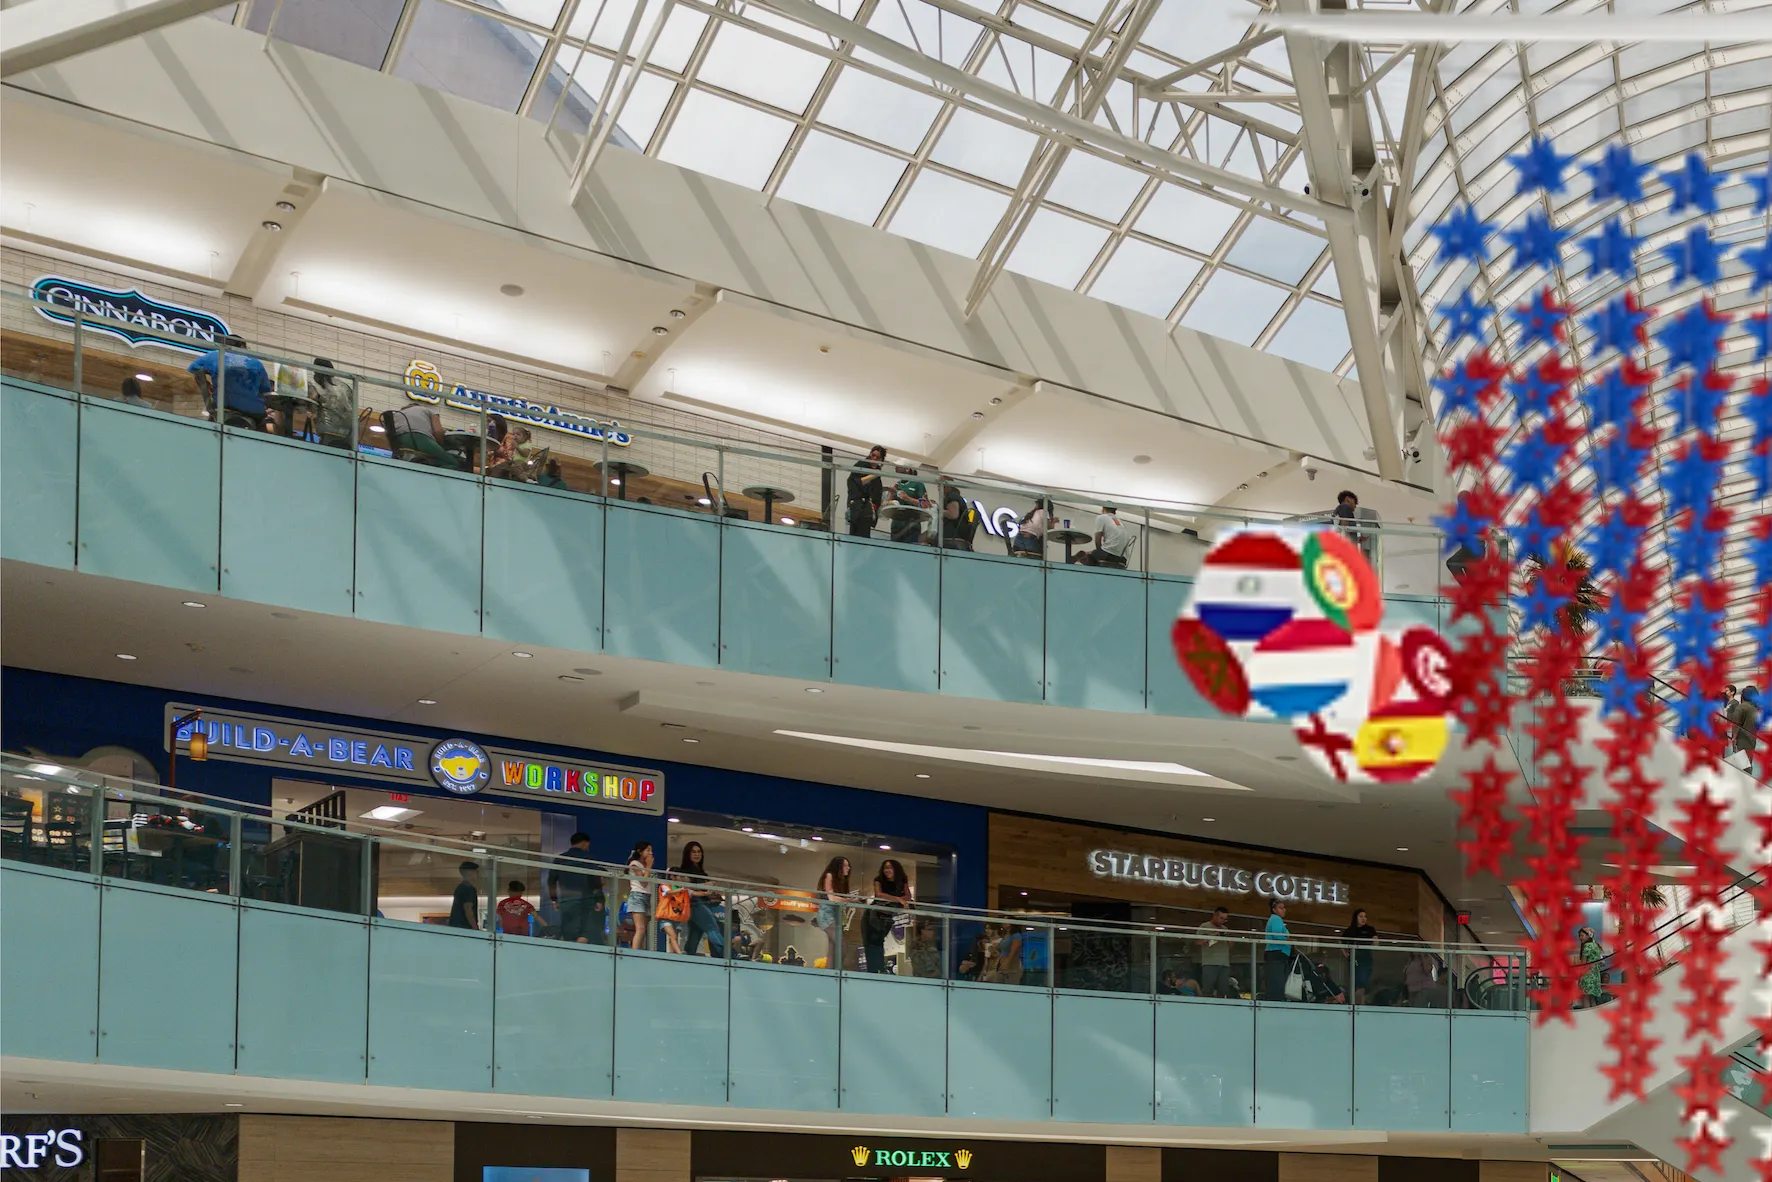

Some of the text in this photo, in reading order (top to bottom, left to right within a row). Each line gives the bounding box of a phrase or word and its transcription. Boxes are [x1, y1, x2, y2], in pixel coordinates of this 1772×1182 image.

[47, 287, 215, 343] CINNABON
[173, 715, 415, 771] BUILD-A-BEAR
[502, 761, 656, 803] WORKSHOP
[1092, 850, 1350, 905] STARBUCKS COFFEE
[875, 1149, 951, 1167] ROLEX
